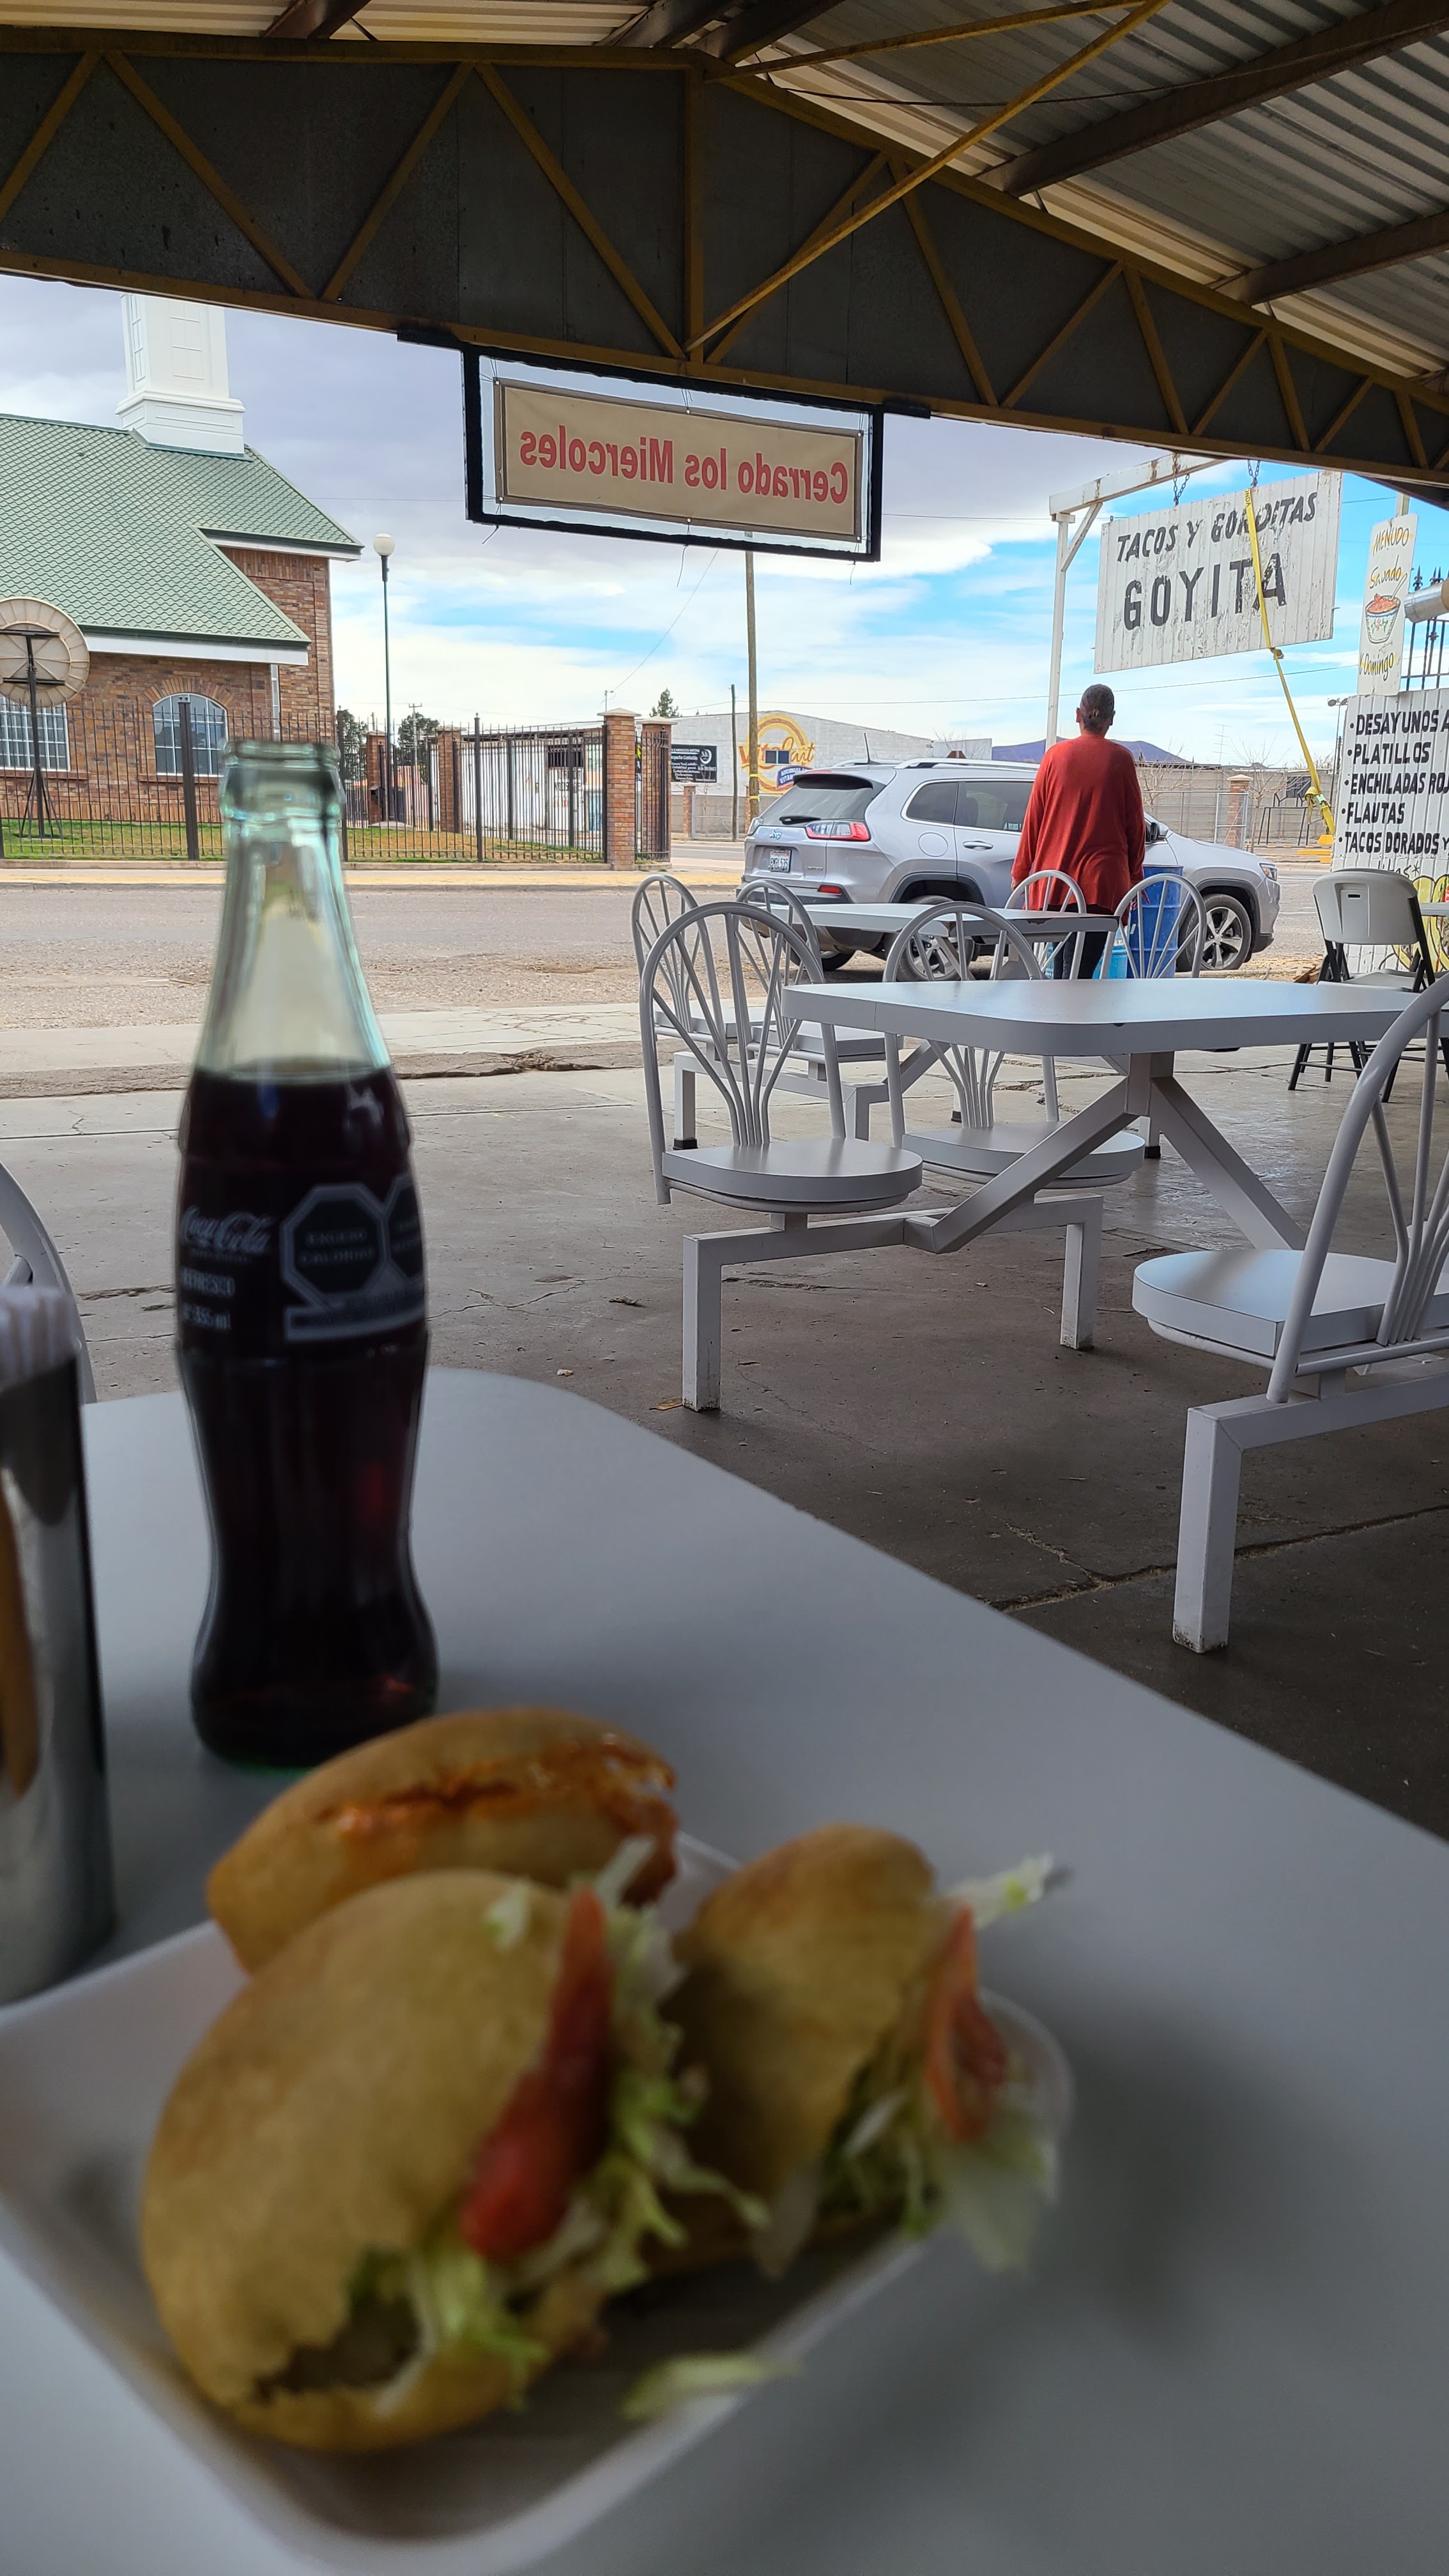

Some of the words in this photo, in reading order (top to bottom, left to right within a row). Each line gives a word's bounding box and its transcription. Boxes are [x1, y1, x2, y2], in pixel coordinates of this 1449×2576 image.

[1117, 525, 1179, 563] TACOS
[1186, 519, 1204, 548] Y
[1211, 491, 1317, 543] GORDITAS
[1124, 553, 1286, 631] GOYITA
[1365, 652, 1394, 682] Domingo
[1355, 710, 1439, 736] DESAYUNOS
[1353, 741, 1431, 765] PLATILLOS
[1350, 772, 1427, 795] ENCHILADAS
[1346, 801, 1406, 825] FLAUTAS
[769, 830, 782, 840] Jeep
[1345, 831, 1383, 854] TACOS
[1384, 832, 1440, 855] DORADOS
[180, 1204, 276, 1255] Coca-Cola
